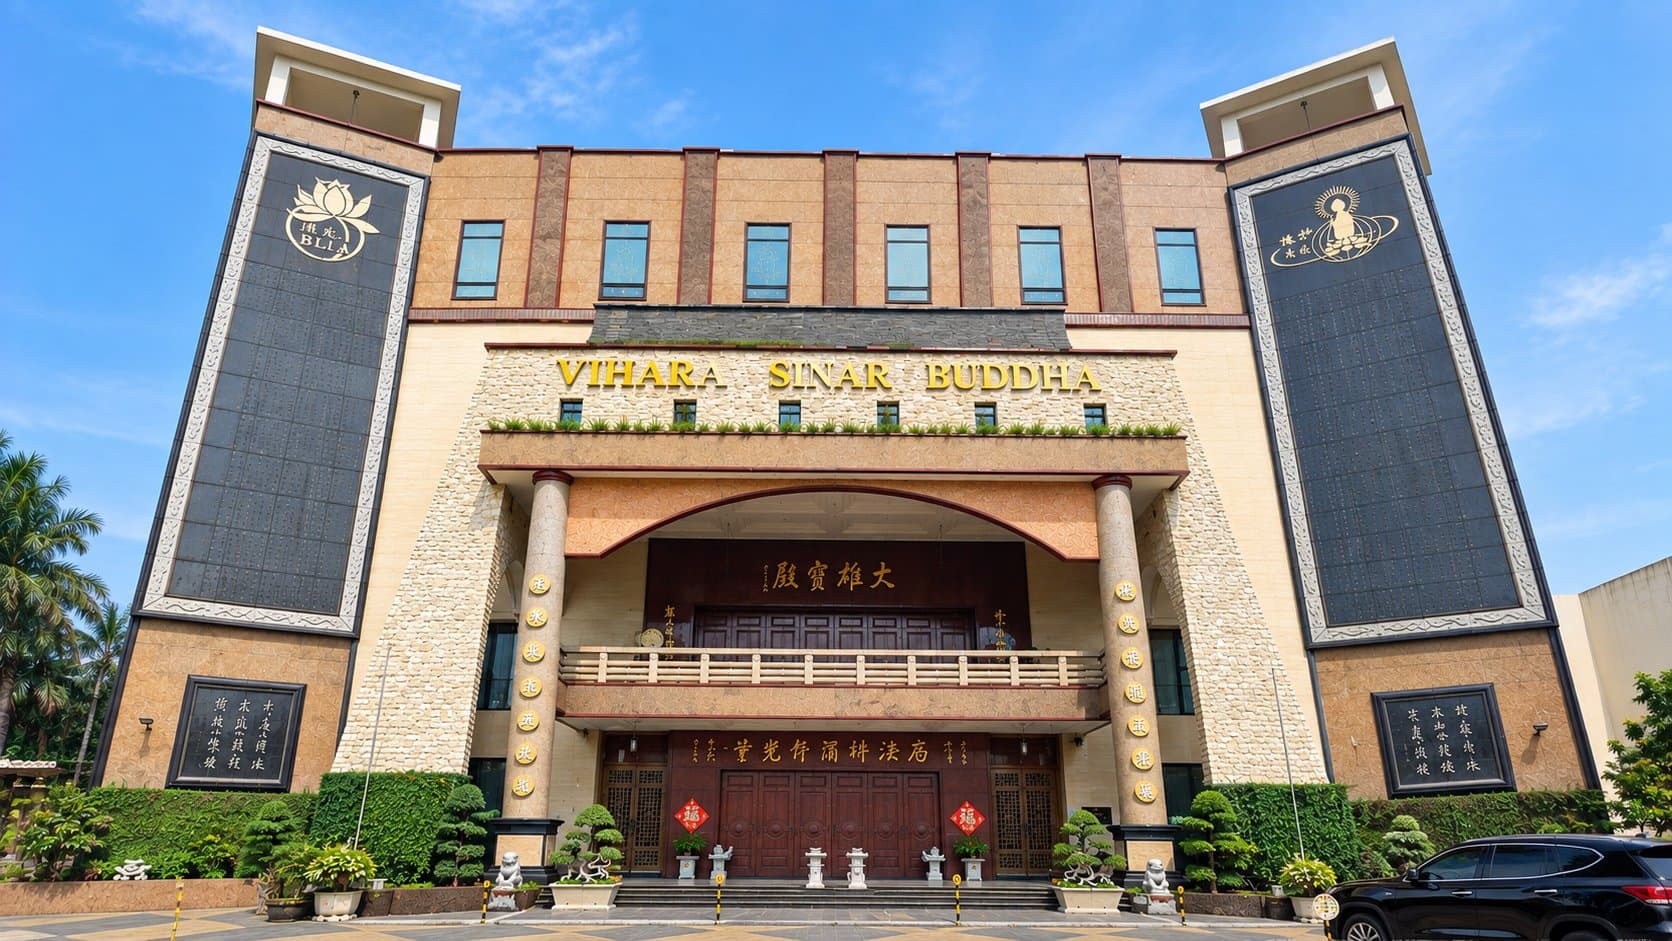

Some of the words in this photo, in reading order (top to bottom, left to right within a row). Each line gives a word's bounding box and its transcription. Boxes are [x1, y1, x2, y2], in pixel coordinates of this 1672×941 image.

[556, 359, 728, 388] VIHARA
[769, 360, 893, 389] SINAR
[926, 361, 1102, 391] BUDDHA
